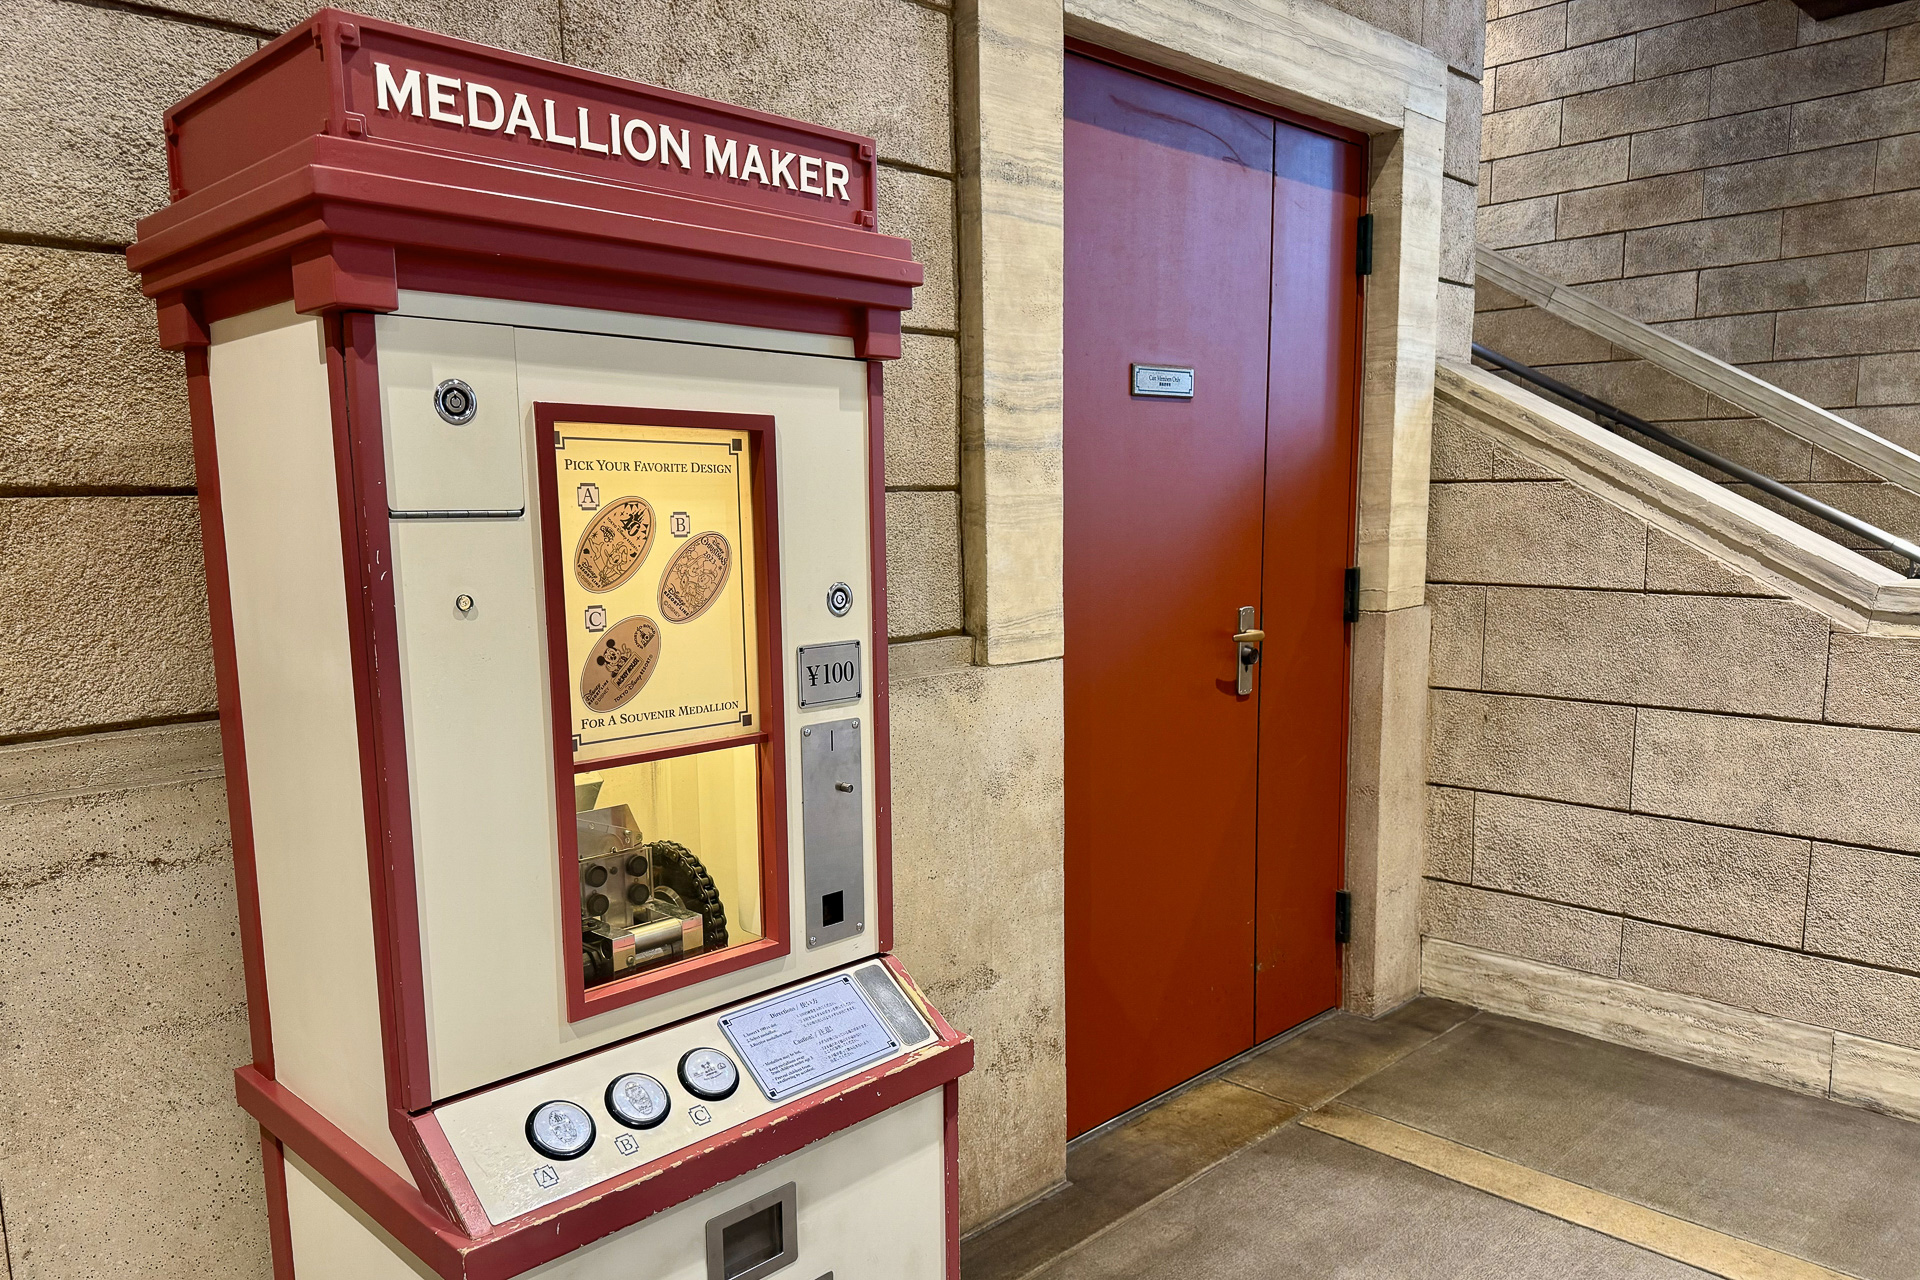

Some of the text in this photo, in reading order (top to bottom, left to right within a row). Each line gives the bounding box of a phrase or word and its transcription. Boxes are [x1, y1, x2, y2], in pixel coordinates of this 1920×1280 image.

[374, 62, 851, 202] MEDALLION MAKER
[564, 459, 732, 474] PICK YOUR FAVORITE DESIGN
[582, 487, 596, 504] A
[675, 517, 686, 531] B
[703, 551, 717, 565] 2023
[589, 612, 602, 627] C
[806, 661, 854, 687] ¥100
[581, 701, 739, 730] FOR A SOUVENIR MEDALLION
[694, 1109, 707, 1121] C
[620, 1138, 633, 1151] B
[541, 1171, 554, 1184] A
